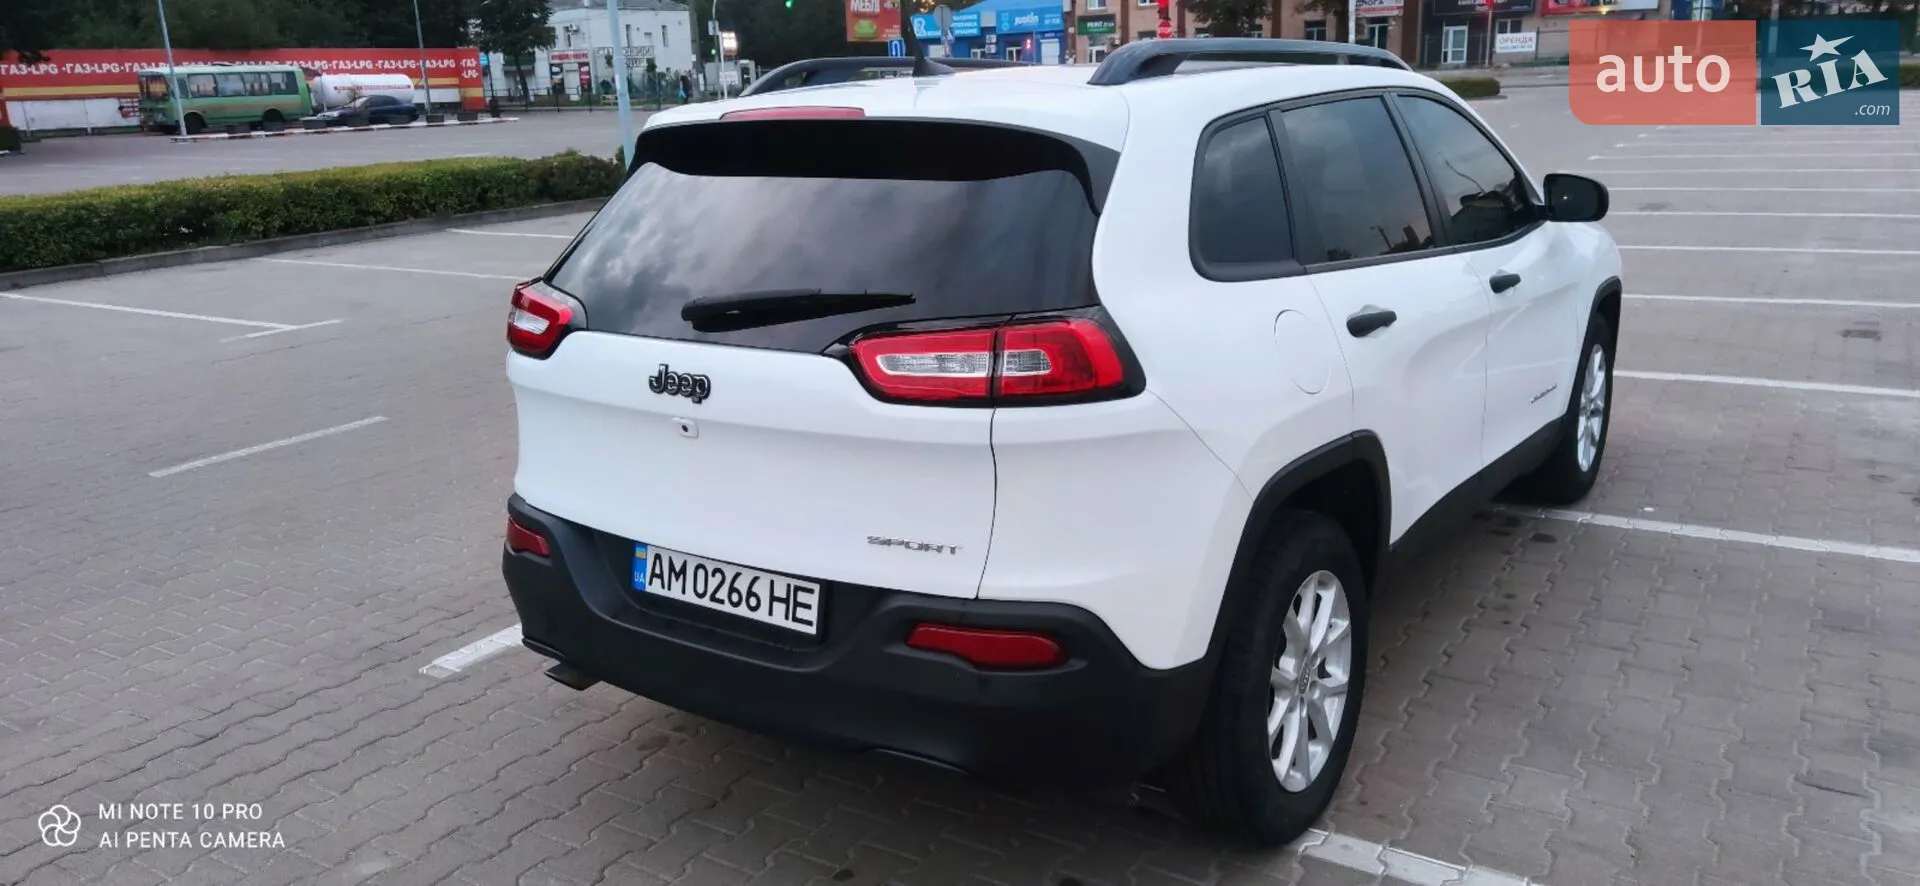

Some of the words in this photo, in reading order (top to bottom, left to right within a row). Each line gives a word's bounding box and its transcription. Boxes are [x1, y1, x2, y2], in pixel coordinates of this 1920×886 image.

[648, 363, 711, 405] Jeep
[866, 535, 963, 555] SPORT
[634, 571, 645, 584] UA
[648, 552, 688, 596] AM
[692, 562, 762, 613] 0266
[768, 578, 816, 627] HE
